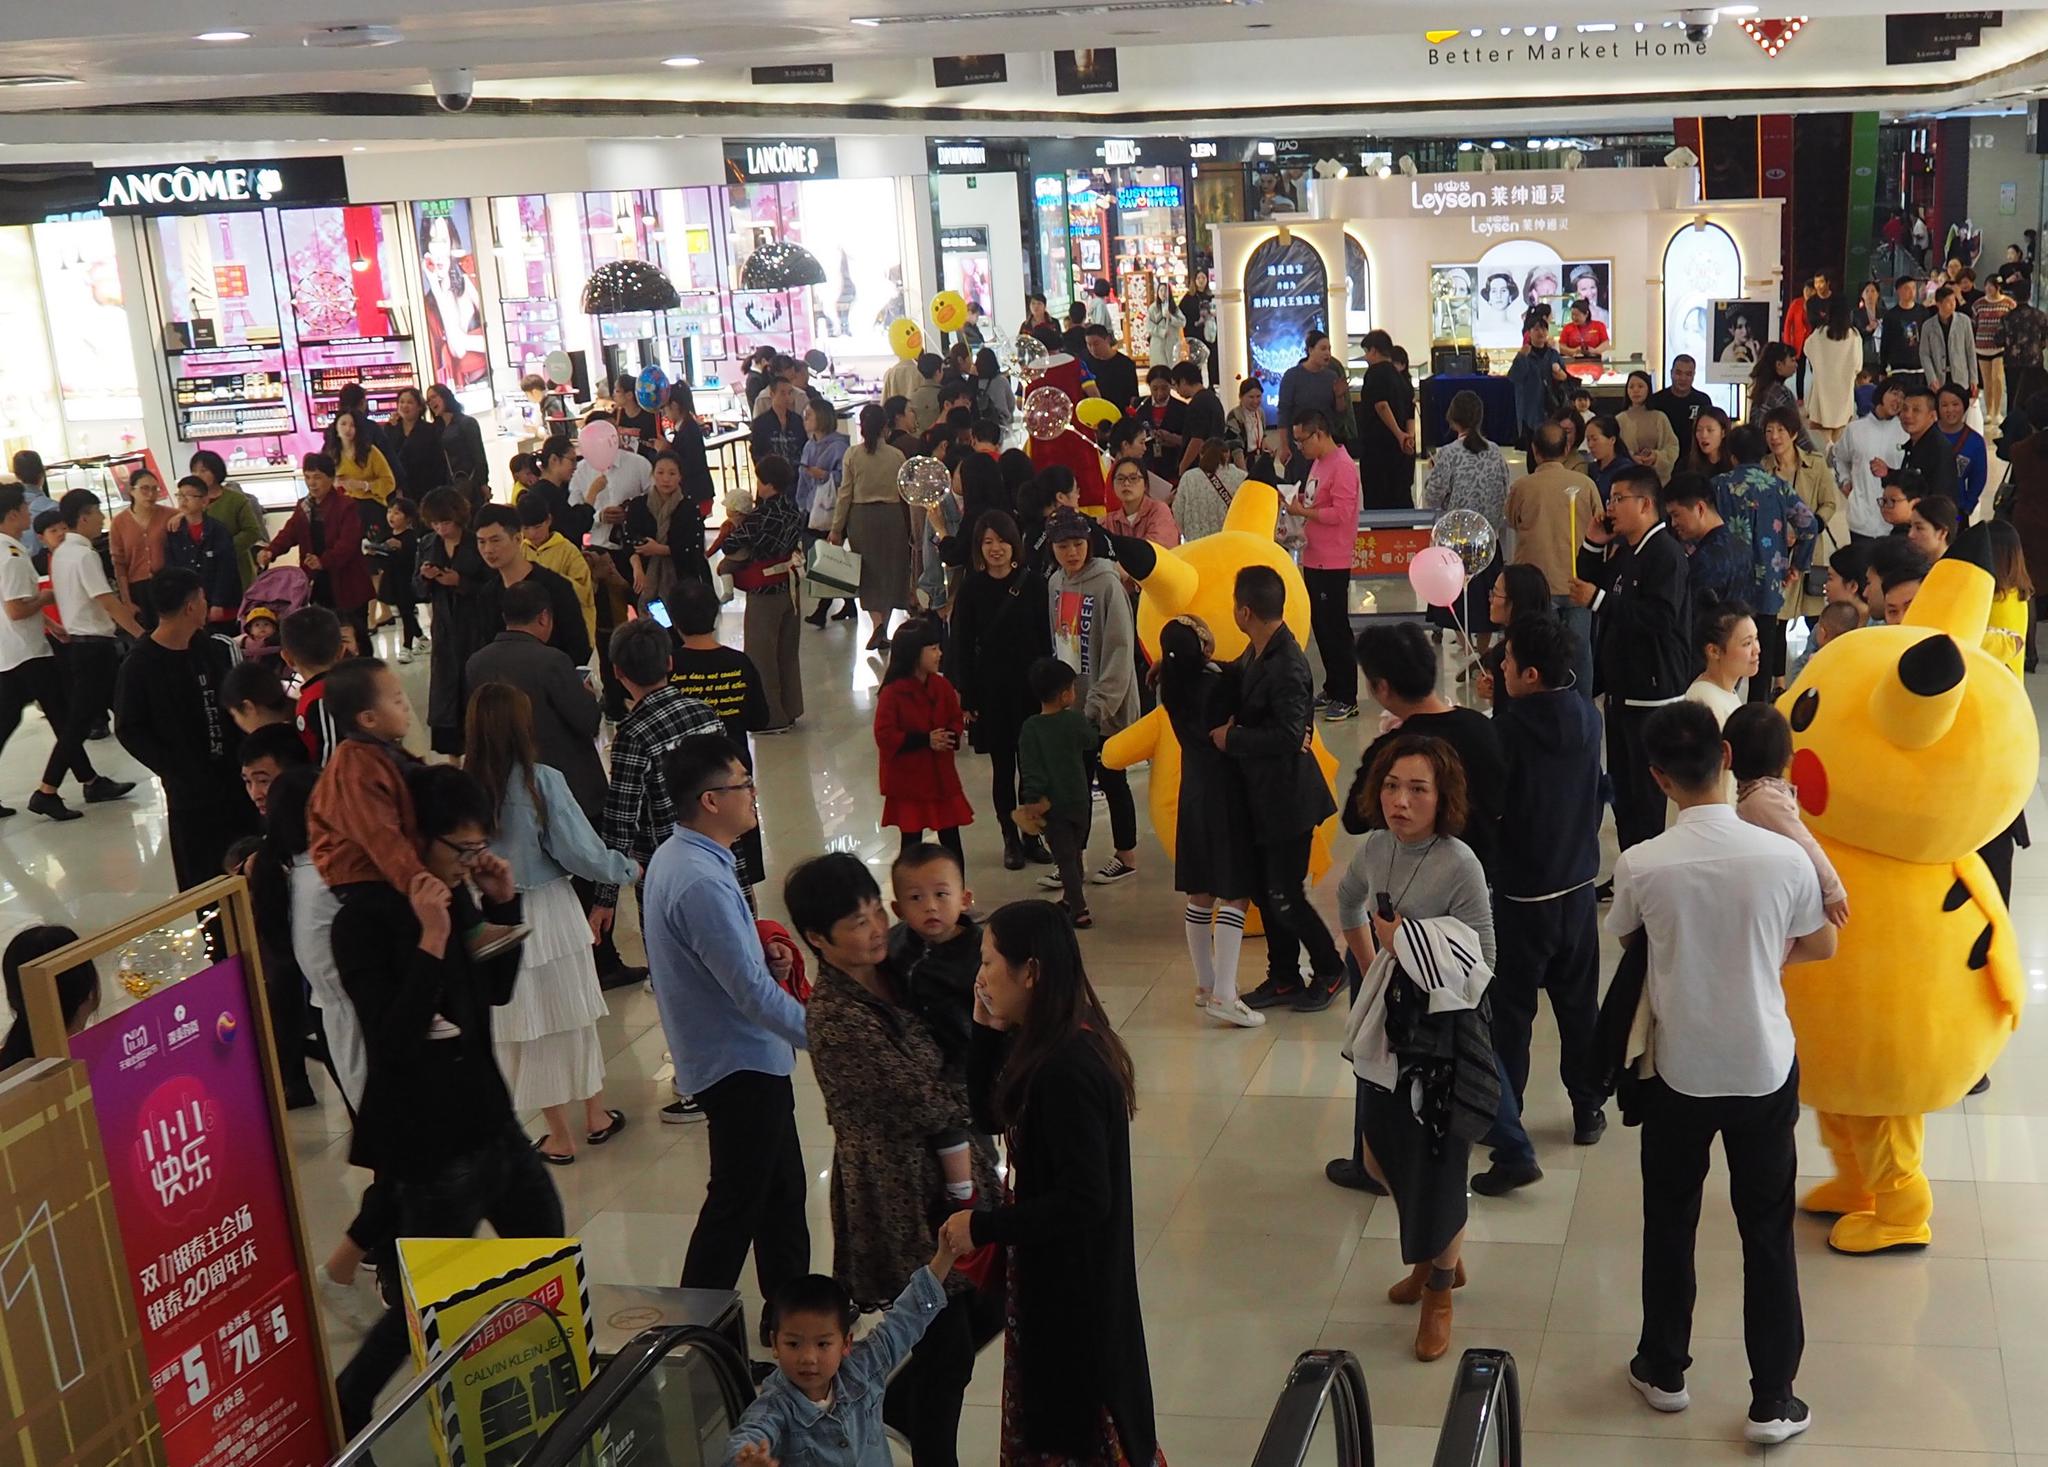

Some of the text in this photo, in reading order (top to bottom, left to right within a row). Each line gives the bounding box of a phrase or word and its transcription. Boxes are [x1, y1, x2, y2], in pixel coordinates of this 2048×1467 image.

[1428, 39, 1708, 65] Better Market Home
[746, 141, 808, 175] LANCÔME
[98, 165, 251, 207] ANCÔME
[1411, 180, 1487, 216] Leysen
[1491, 183, 1566, 207] 莱绅通灵
[1080, 595, 1095, 676] HILFIGER
[151, 1134, 211, 1207] 快乐
[146, 1238, 259, 1331] 银泰20周年庆
[270, 1303, 290, 1345] 5
[228, 1324, 262, 1375] 70
[463, 1326, 575, 1386] CALVIN KLEIN JEAS
[181, 1343, 211, 1407] 5
